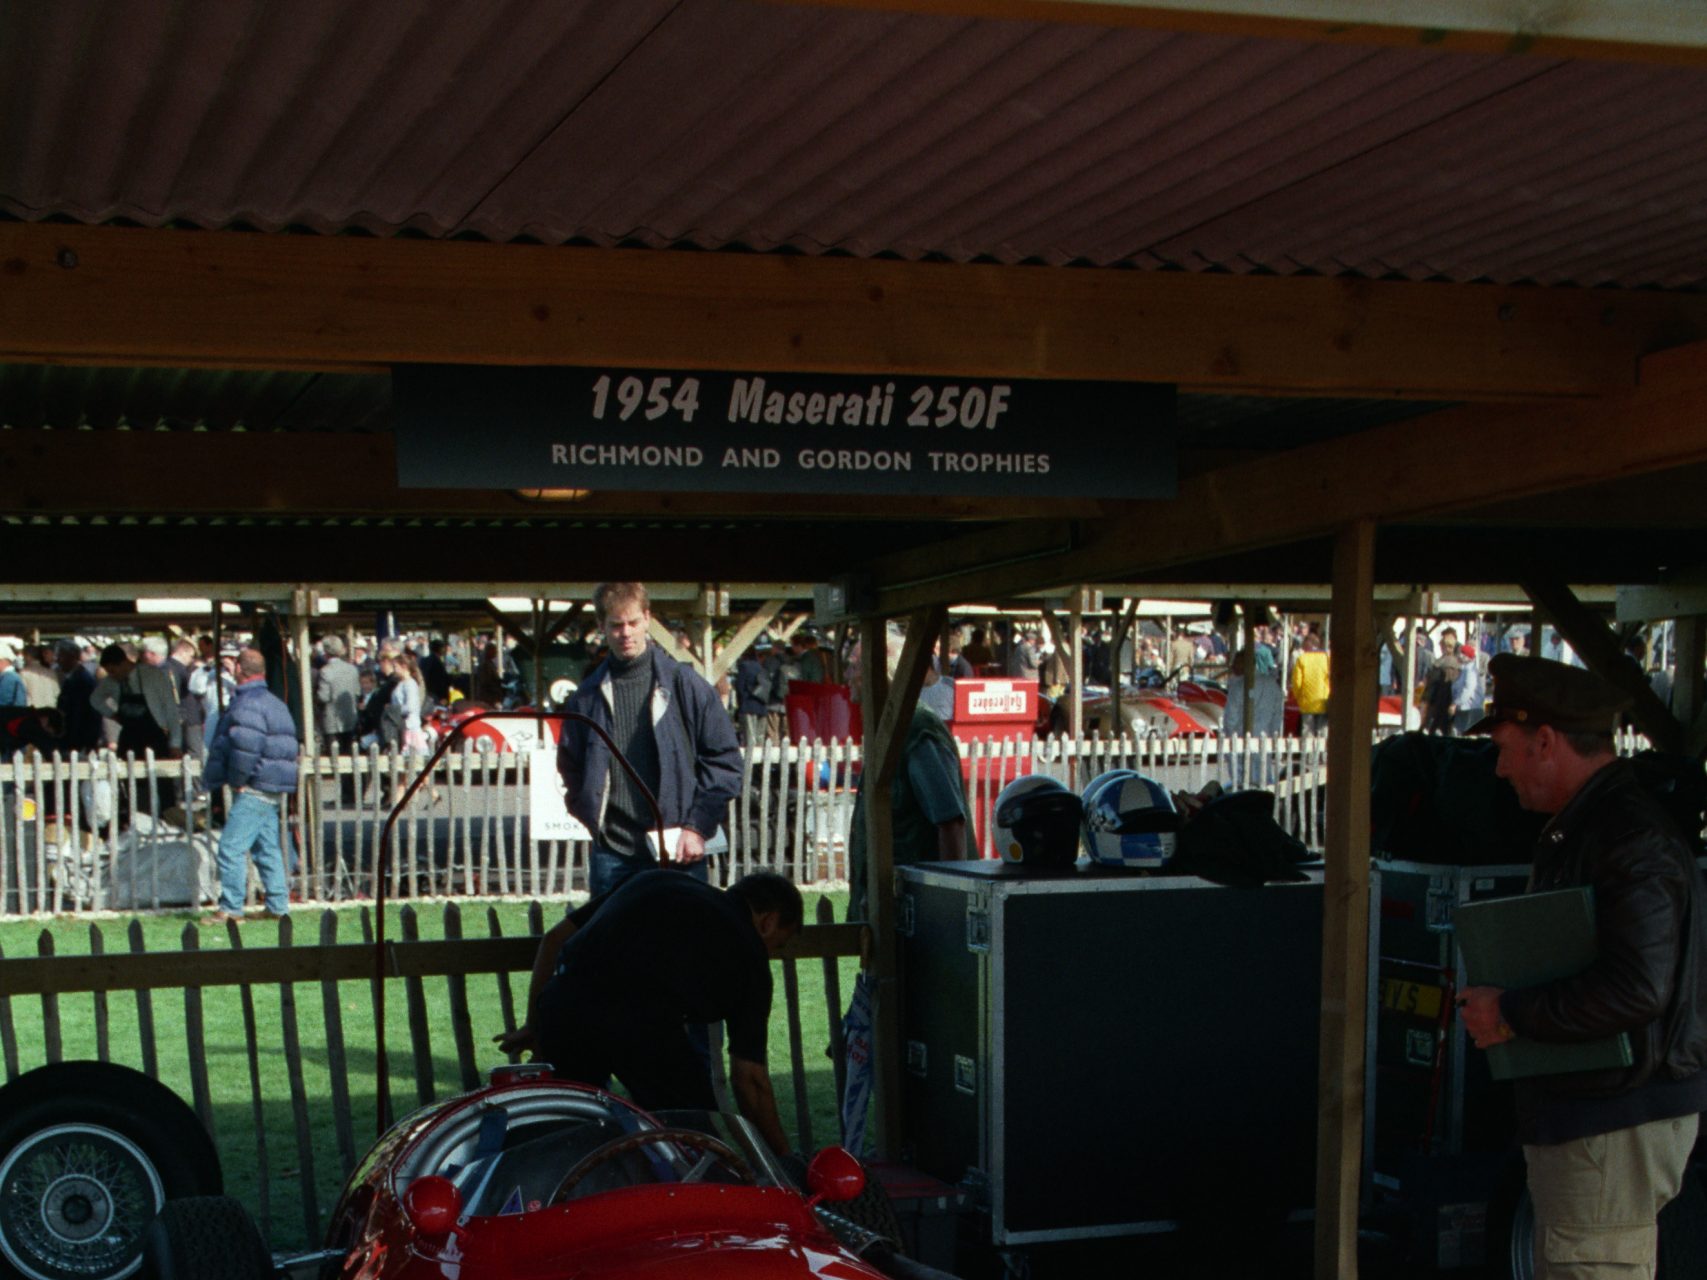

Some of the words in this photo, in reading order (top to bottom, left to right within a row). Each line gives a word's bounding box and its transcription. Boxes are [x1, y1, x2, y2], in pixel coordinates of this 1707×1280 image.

[592, 374, 700, 422] 1954
[728, 376, 896, 426] Maserati
[907, 384, 1012, 430] 250F
[552, 444, 704, 467] RICHMOND
[721, 447, 781, 468] AND
[798, 449, 912, 471] GORDON
[928, 453, 1051, 474] TROPHIES
[544, 822, 580, 832] SMOK
